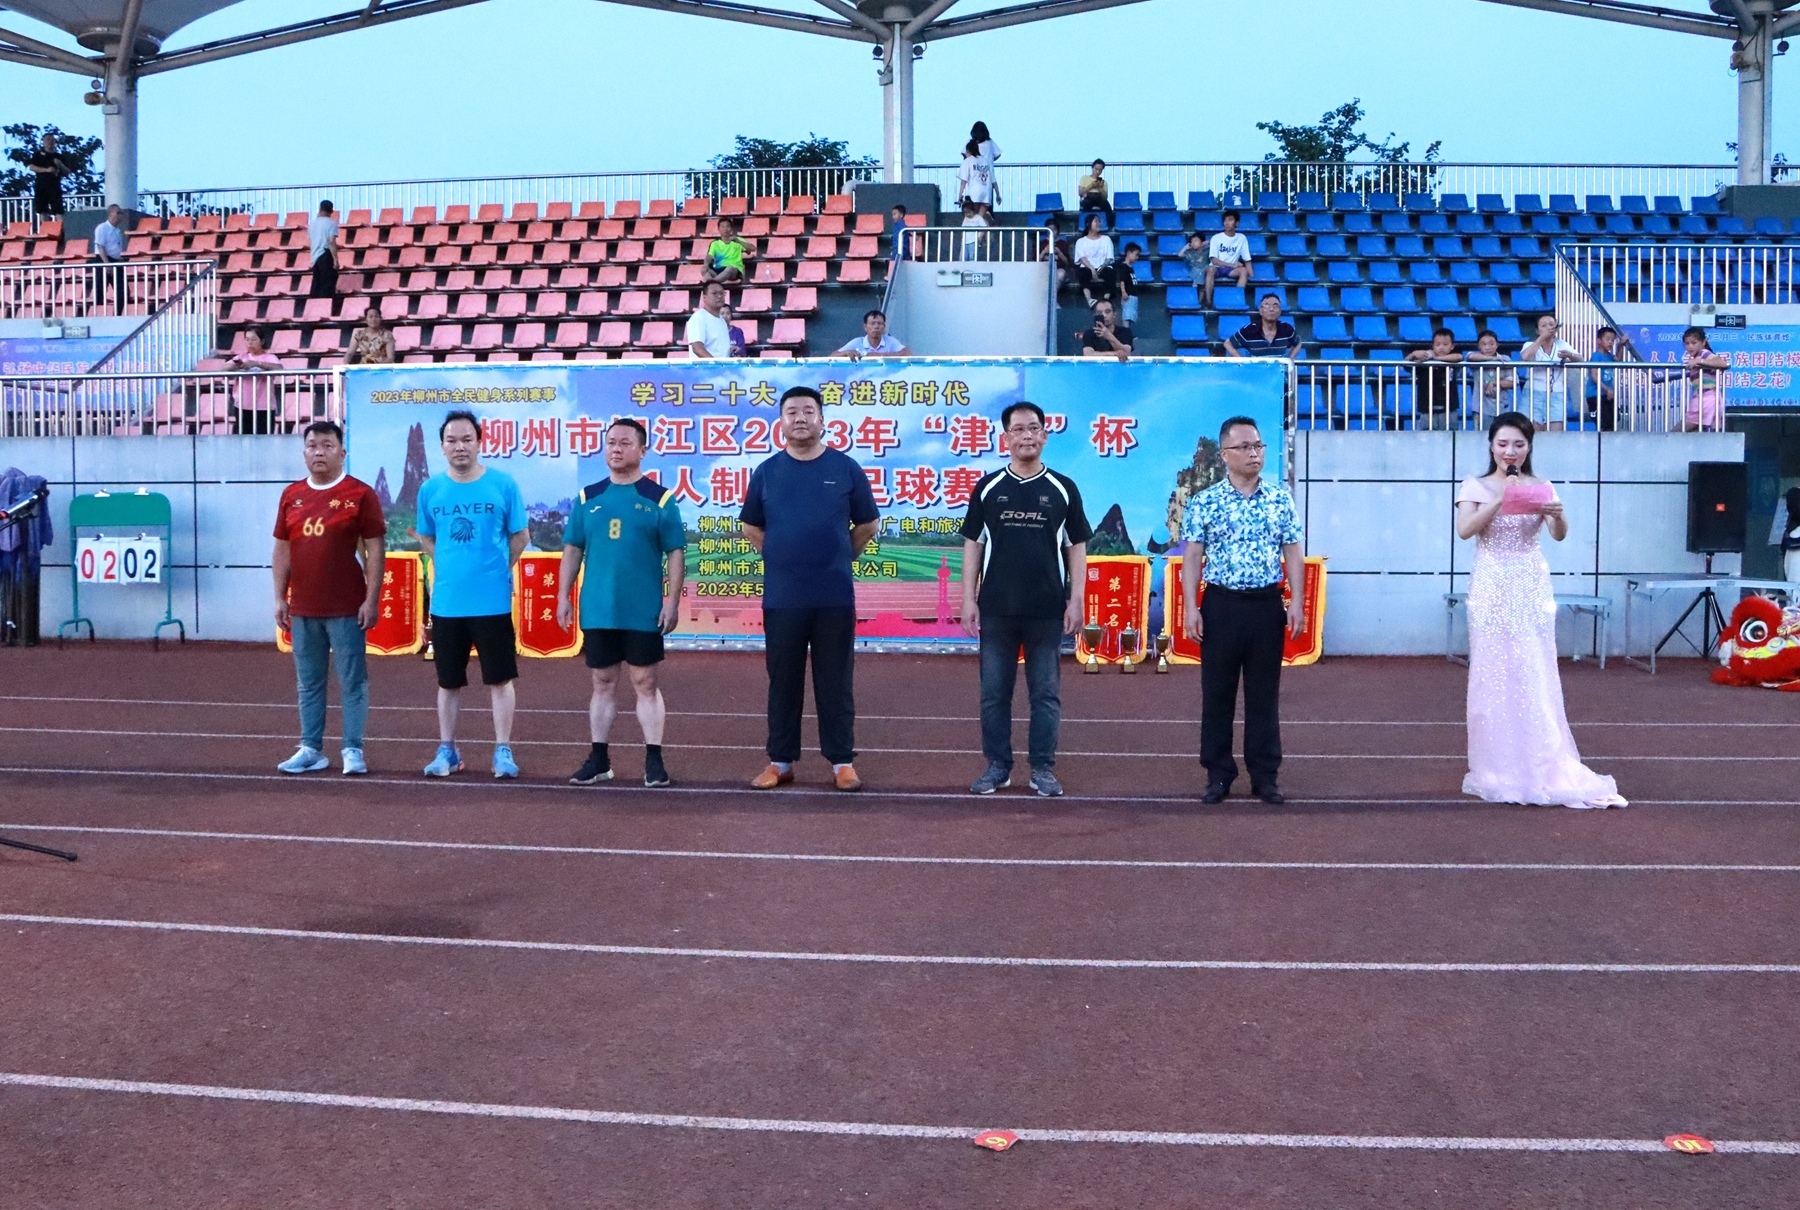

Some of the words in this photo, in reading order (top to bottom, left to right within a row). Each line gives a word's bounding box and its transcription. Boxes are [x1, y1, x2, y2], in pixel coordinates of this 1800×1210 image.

[371, 387, 556, 403] 2023年柳州市全民健身系列赛事
[631, 381, 776, 406] 学习二十大
[819, 380, 970, 406] 奋进新时代
[432, 502, 496, 518] PLAYER
[1002, 510, 1048, 521] GOAL
[302, 516, 326, 537] 66
[608, 518, 622, 540] 8
[540, 571, 555, 621] 第一名
[1106, 576, 1122, 628] 第二名
